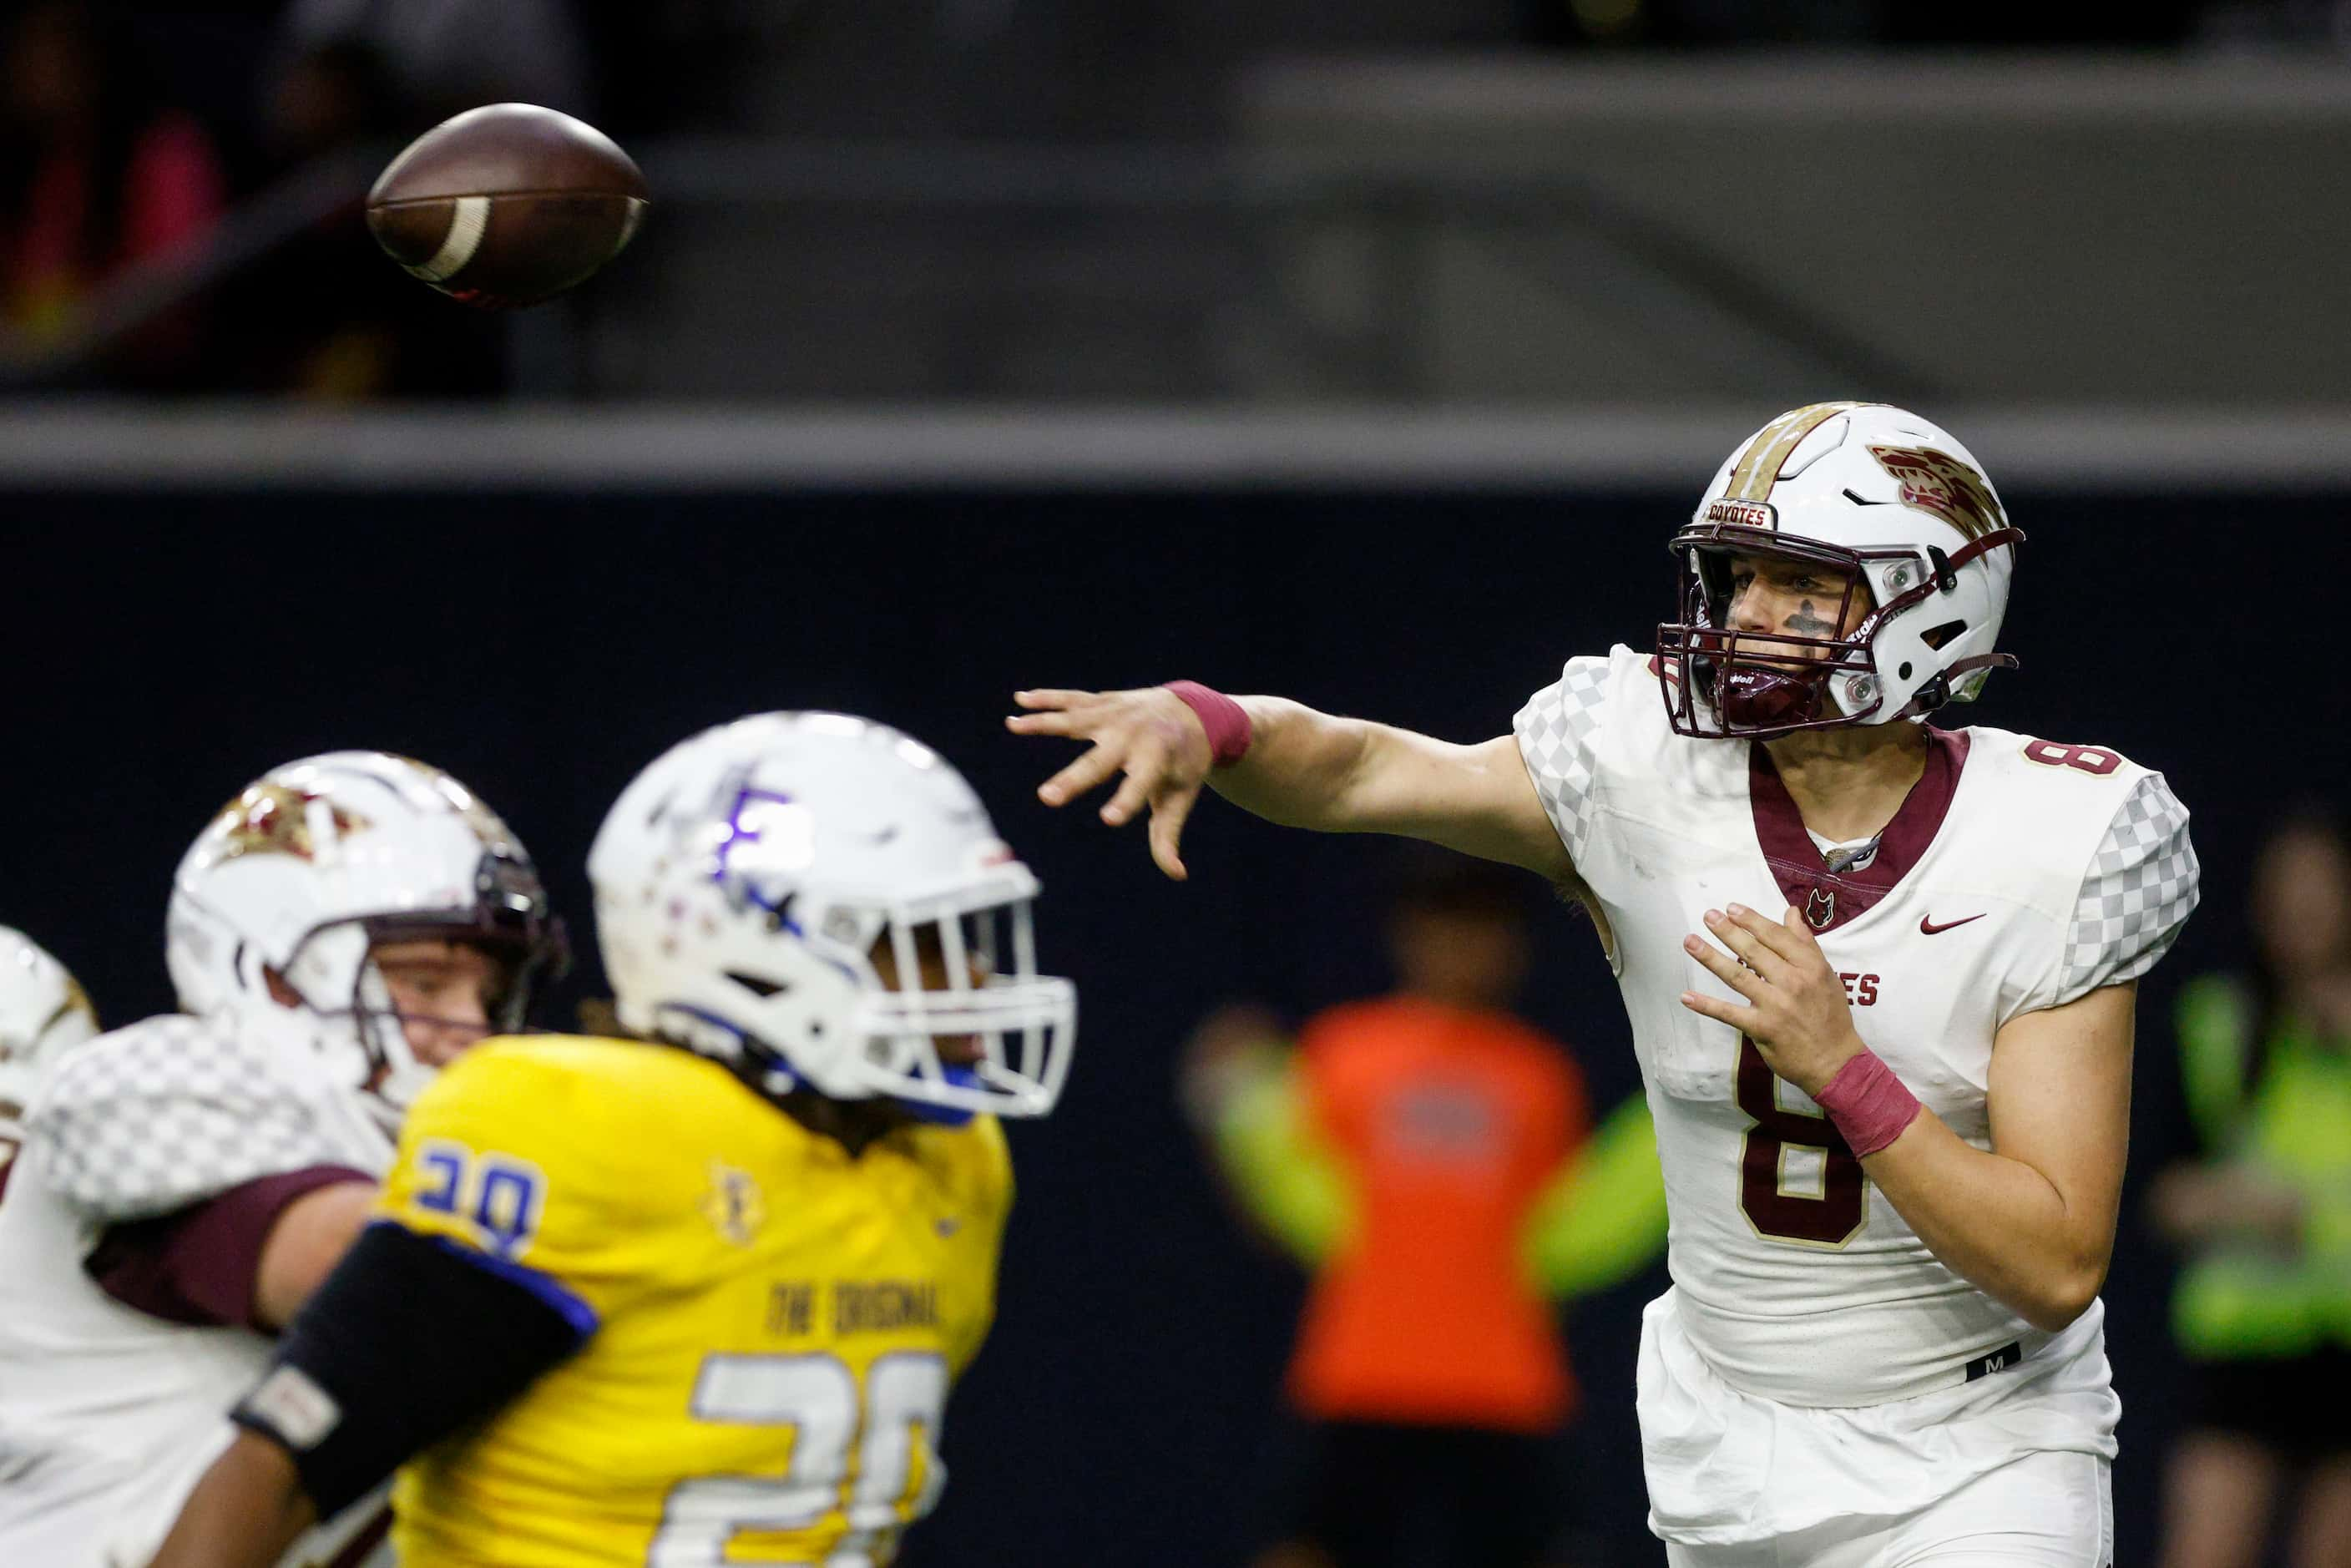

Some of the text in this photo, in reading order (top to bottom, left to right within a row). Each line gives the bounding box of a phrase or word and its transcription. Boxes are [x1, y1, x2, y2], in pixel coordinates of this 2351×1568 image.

[1709, 504, 1766, 526] COYOTES
[2019, 739, 2129, 778] 8
[1732, 1029, 1871, 1251] 8
[414, 1141, 548, 1254] 20
[1985, 1356, 2004, 1374] M
